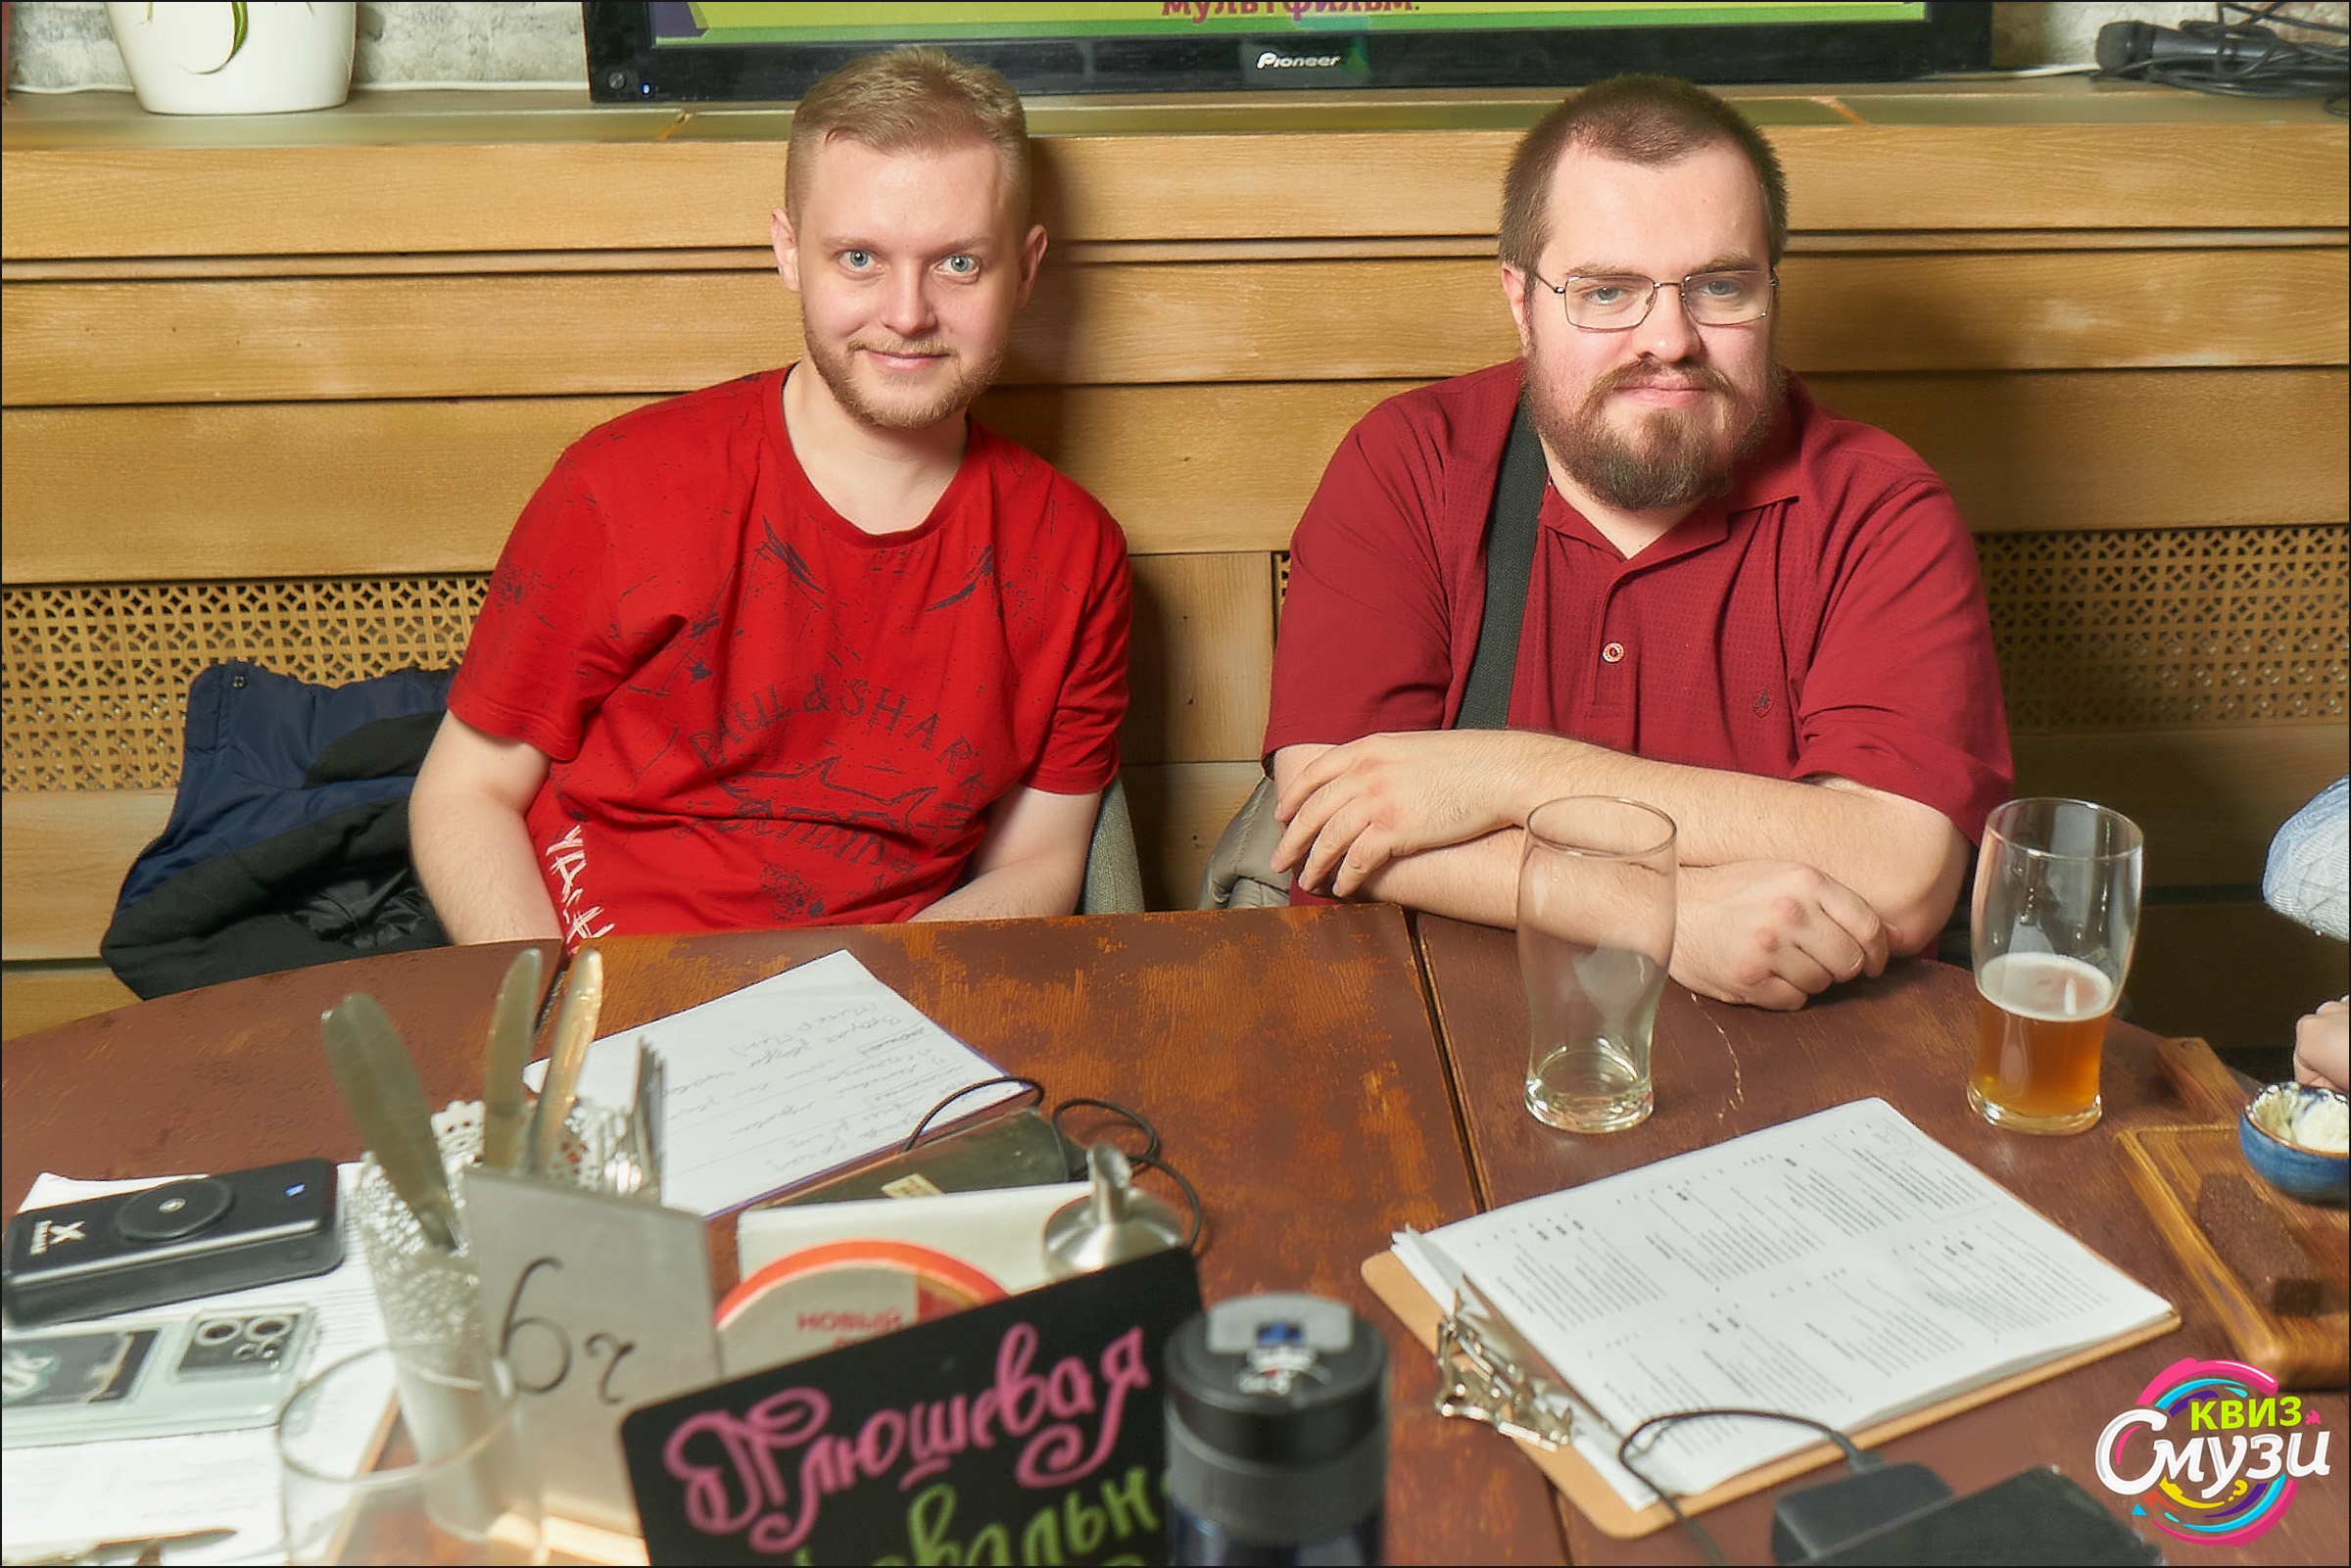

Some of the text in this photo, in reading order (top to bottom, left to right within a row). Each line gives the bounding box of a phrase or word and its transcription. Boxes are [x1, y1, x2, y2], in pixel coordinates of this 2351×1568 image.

[1256, 52, 1341, 70] Pioneer
[795, 1307, 902, 1334] НОВЫЙ
[662, 1321, 1150, 1553] Плюшевая
